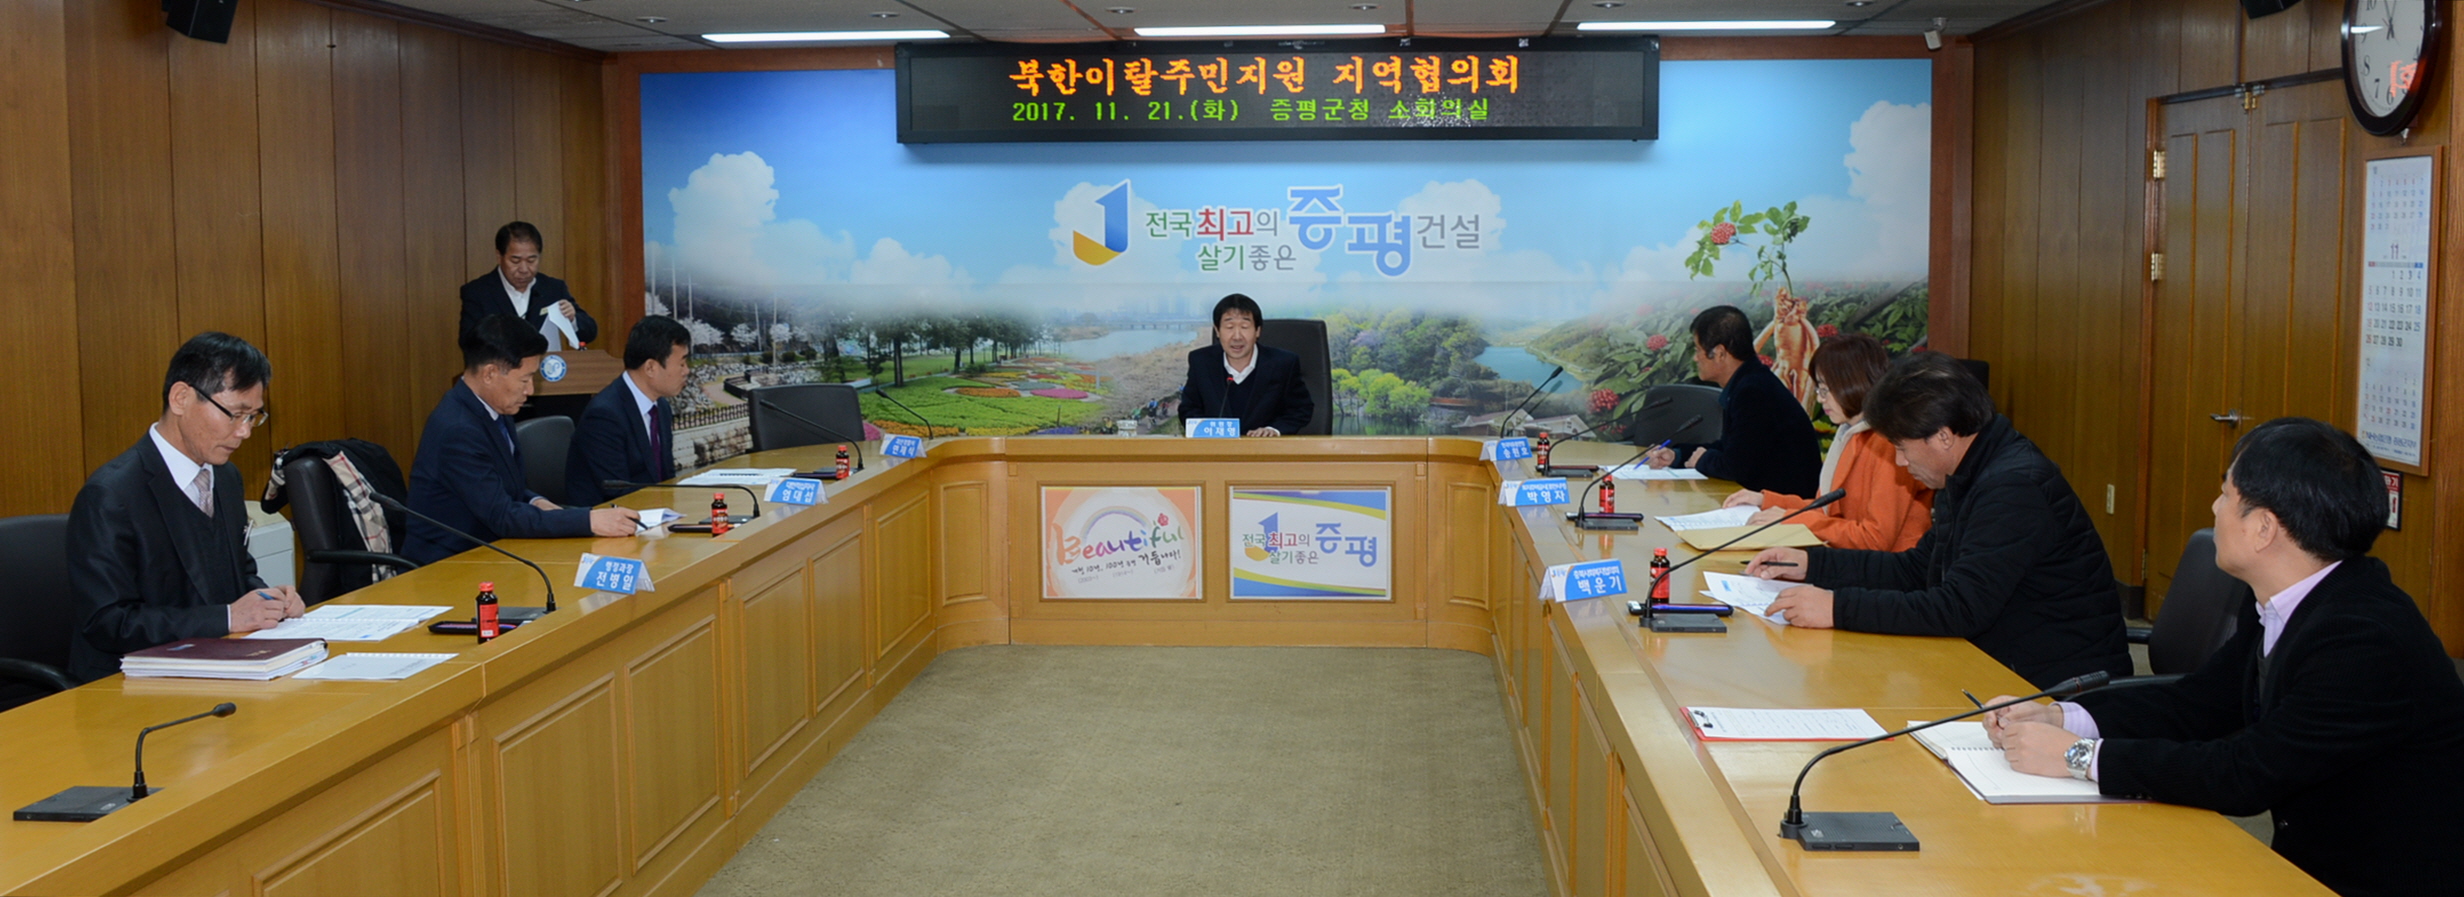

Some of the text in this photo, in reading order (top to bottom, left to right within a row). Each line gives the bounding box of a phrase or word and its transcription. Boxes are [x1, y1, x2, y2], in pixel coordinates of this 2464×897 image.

[1009, 55, 1519, 96] 북한이탈주민지원 지역협의회
[1012, 102, 1075, 121] 2017.
[1095, 102, 1129, 121] 11.
[1270, 98, 1369, 121] 증평군청
[1388, 98, 1489, 121] 소회의실
[1051, 522, 1184, 566] Beautiful
[1315, 522, 1377, 568] 증평
[1577, 576, 1623, 595] 백운기
